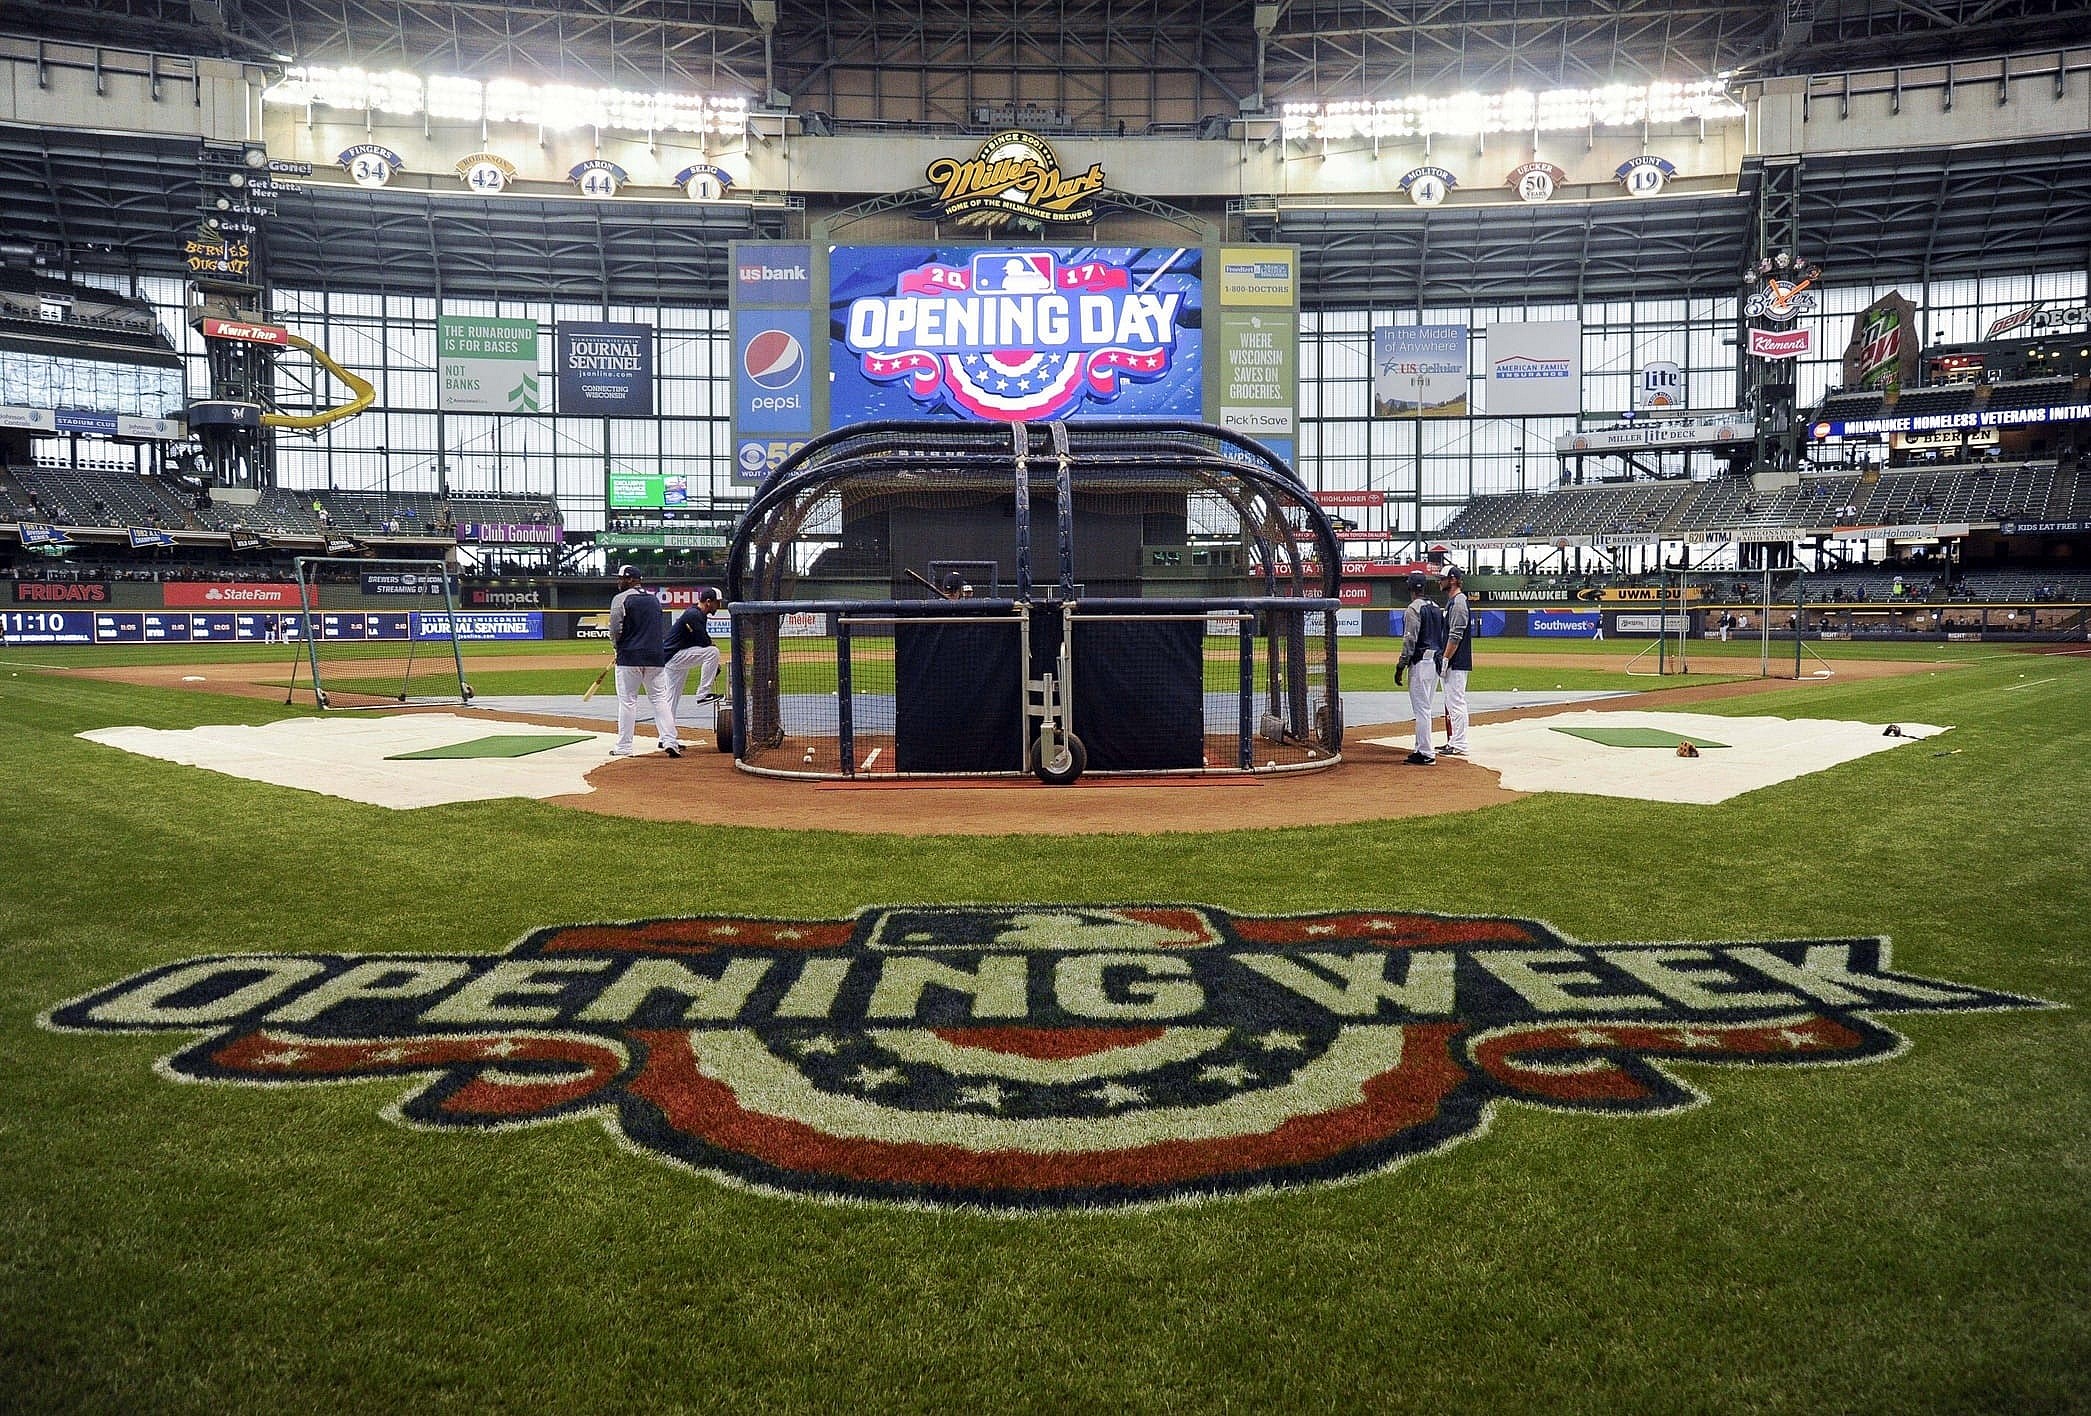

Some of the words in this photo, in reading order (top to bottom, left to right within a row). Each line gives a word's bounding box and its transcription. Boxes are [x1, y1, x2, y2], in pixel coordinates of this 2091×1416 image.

[989, 133, 1020, 149] SINCE
[1021, 134, 1044, 148] 2001
[349, 145, 393, 159] FINGERS
[268, 161, 312, 174] Gone!
[583, 161, 614, 171] AARON
[1518, 163, 1553, 174] UECKER
[1629, 157, 1662, 166] YOUNT
[356, 161, 385, 180] 34
[690, 165, 717, 174] SELIG
[1408, 168, 1448, 180] MOLITOR
[248, 180, 268, 188] Get
[472, 169, 500, 188] 42
[585, 175, 612, 194] 44
[928, 158, 1036, 200] Miller
[1017, 163, 1104, 207] Park
[1526, 176, 1546, 190] 50
[1633, 172, 1659, 191] 19
[252, 189, 279, 198] Here
[699, 181, 710, 198] 1
[1420, 182, 1434, 200] 4
[233, 205, 251, 213] Get
[946, 202, 969, 214] HOME
[970, 199, 982, 208] OF
[984, 199, 1001, 207] THE
[1003, 201, 1051, 220] MILWAUKEE
[1052, 209, 1093, 221] BREWERS
[850, 296, 1069, 349] OPENING
[1079, 293, 1180, 345] DAY
[444, 325, 464, 337] THE
[469, 327, 532, 340] RUNAROUND
[1384, 329, 1395, 340] In
[1398, 329, 1416, 339] the
[1420, 328, 1458, 339] Middle
[445, 339, 455, 350] IS
[460, 340, 481, 352] FOR
[484, 341, 519, 353] BASES
[1240, 333, 1273, 349] WHERE
[1385, 342, 1396, 352] of
[1400, 342, 1457, 353] Anywhere
[1755, 336, 1807, 350] Klement's
[569, 342, 642, 357] JOURNAL
[569, 356, 642, 370] SENTINEL
[1230, 350, 1283, 366] WISCONSIN
[446, 365, 465, 377] NOT
[579, 370, 633, 378] jsonline.com
[1540, 363, 1569, 371] FAMILY
[1234, 368, 1264, 382] SAVES
[1266, 368, 1279, 382] ON
[1645, 370, 1677, 391] Lite
[446, 379, 480, 391] BANKS
[1229, 385, 1283, 400] GROCERIES.
[752, 394, 801, 412] pepsi
[57, 418, 94, 426] STADIUM
[1225, 415, 1249, 425] Pick
[1260, 415, 1288, 425] Save
[1844, 418, 1911, 434] MILWAUKEE
[1913, 413, 1977, 429] HOMELESS
[1980, 408, 2046, 424] VETERANS
[1608, 434, 1642, 443] MILLER
[1670, 430, 1696, 439] DECK
[1924, 432, 1960, 442] BEER
[2056, 522, 2078, 530] FREE
[481, 524, 504, 542] Club
[508, 524, 556, 543] Goodwill
[1688, 533, 1704, 544] 620
[1706, 532, 1732, 542] WTMJ
[671, 536, 698, 545] CHECK
[700, 536, 721, 546] DECK
[18, 583, 104, 601] FRIDAYS
[377, 585, 417, 593] STREAMING
[485, 590, 539, 604] impact
[0, 613, 64, 631] 11:10
[475, 622, 529, 633] SENTINEL
[1533, 619, 1587, 631] Southwest
[86, 952, 1206, 1025] OPENING
[1232, 933, 1984, 1015] WEEK
